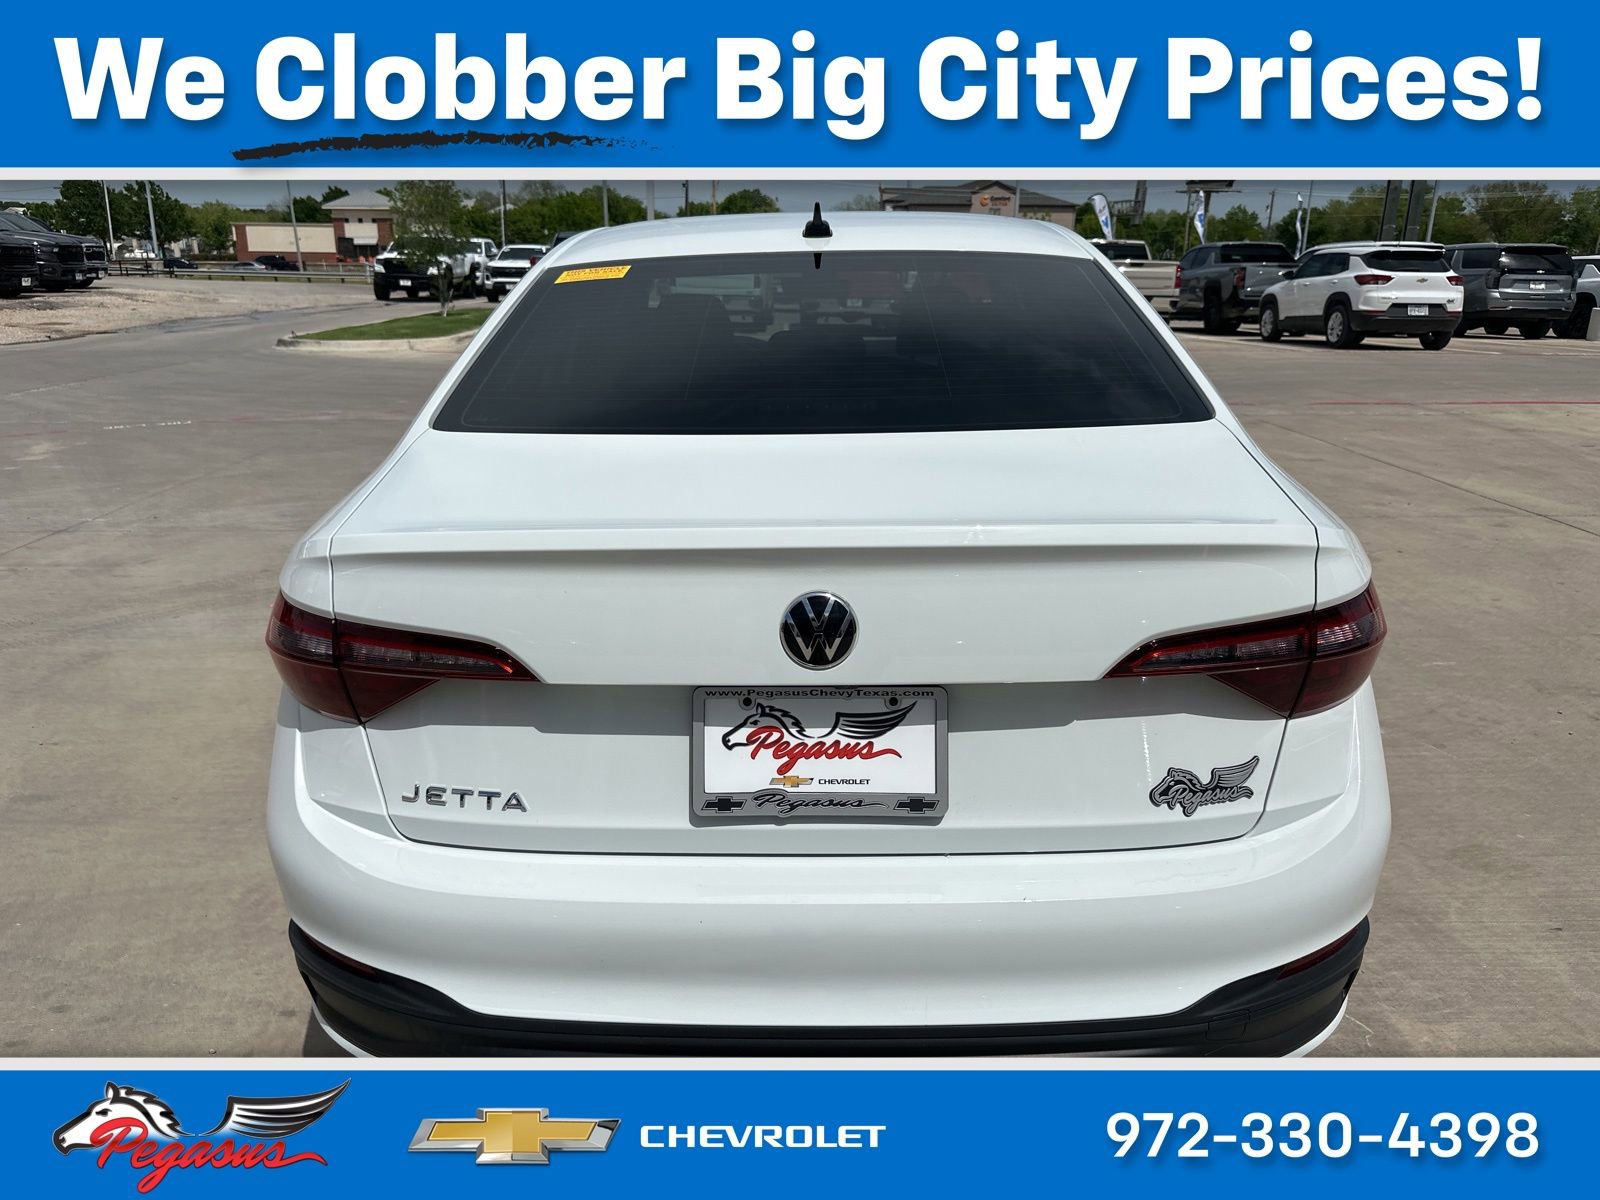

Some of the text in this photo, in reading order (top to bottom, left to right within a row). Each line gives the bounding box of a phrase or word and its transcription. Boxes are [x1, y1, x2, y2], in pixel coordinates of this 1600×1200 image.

[705, 688, 934, 699] www.PegasusChevyTexas.com
[746, 726, 902, 775] Pegasus
[818, 778, 871, 786] CHEVROLET
[401, 784, 528, 813] JETTA
[753, 793, 888, 815] Pegasus
[1168, 784, 1253, 816] Pegasus
